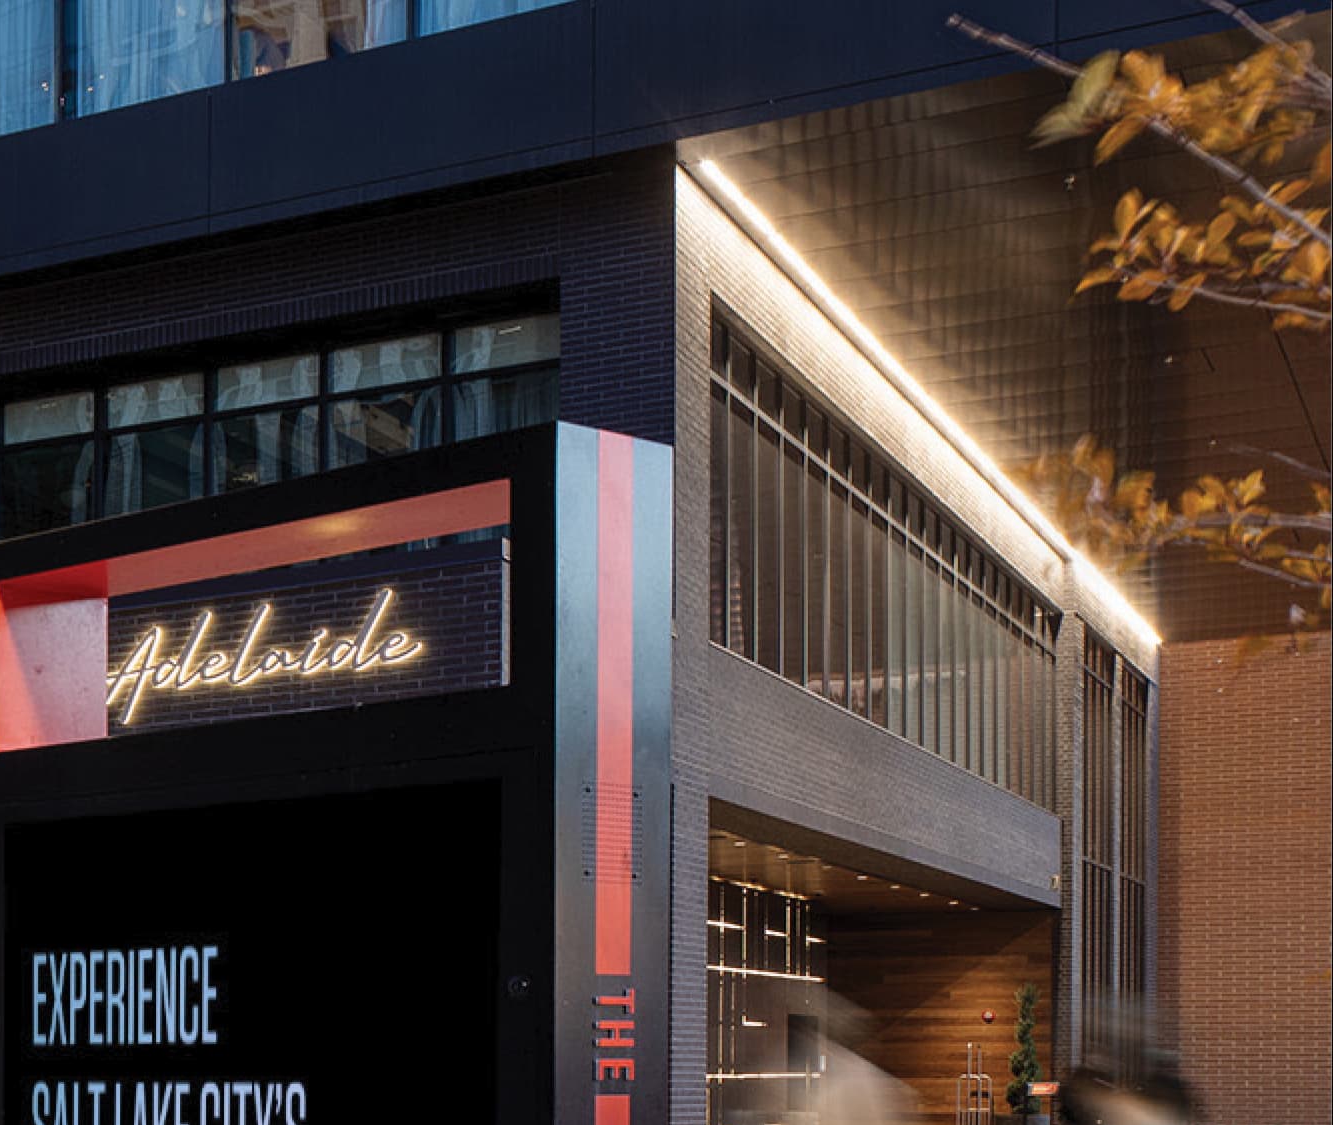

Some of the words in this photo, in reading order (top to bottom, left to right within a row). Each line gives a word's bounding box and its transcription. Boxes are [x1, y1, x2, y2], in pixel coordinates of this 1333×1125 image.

[106, 587, 425, 726] Adelaide
[33, 945, 218, 1046] EXPERIENCE
[593, 988, 635, 1081] THE
